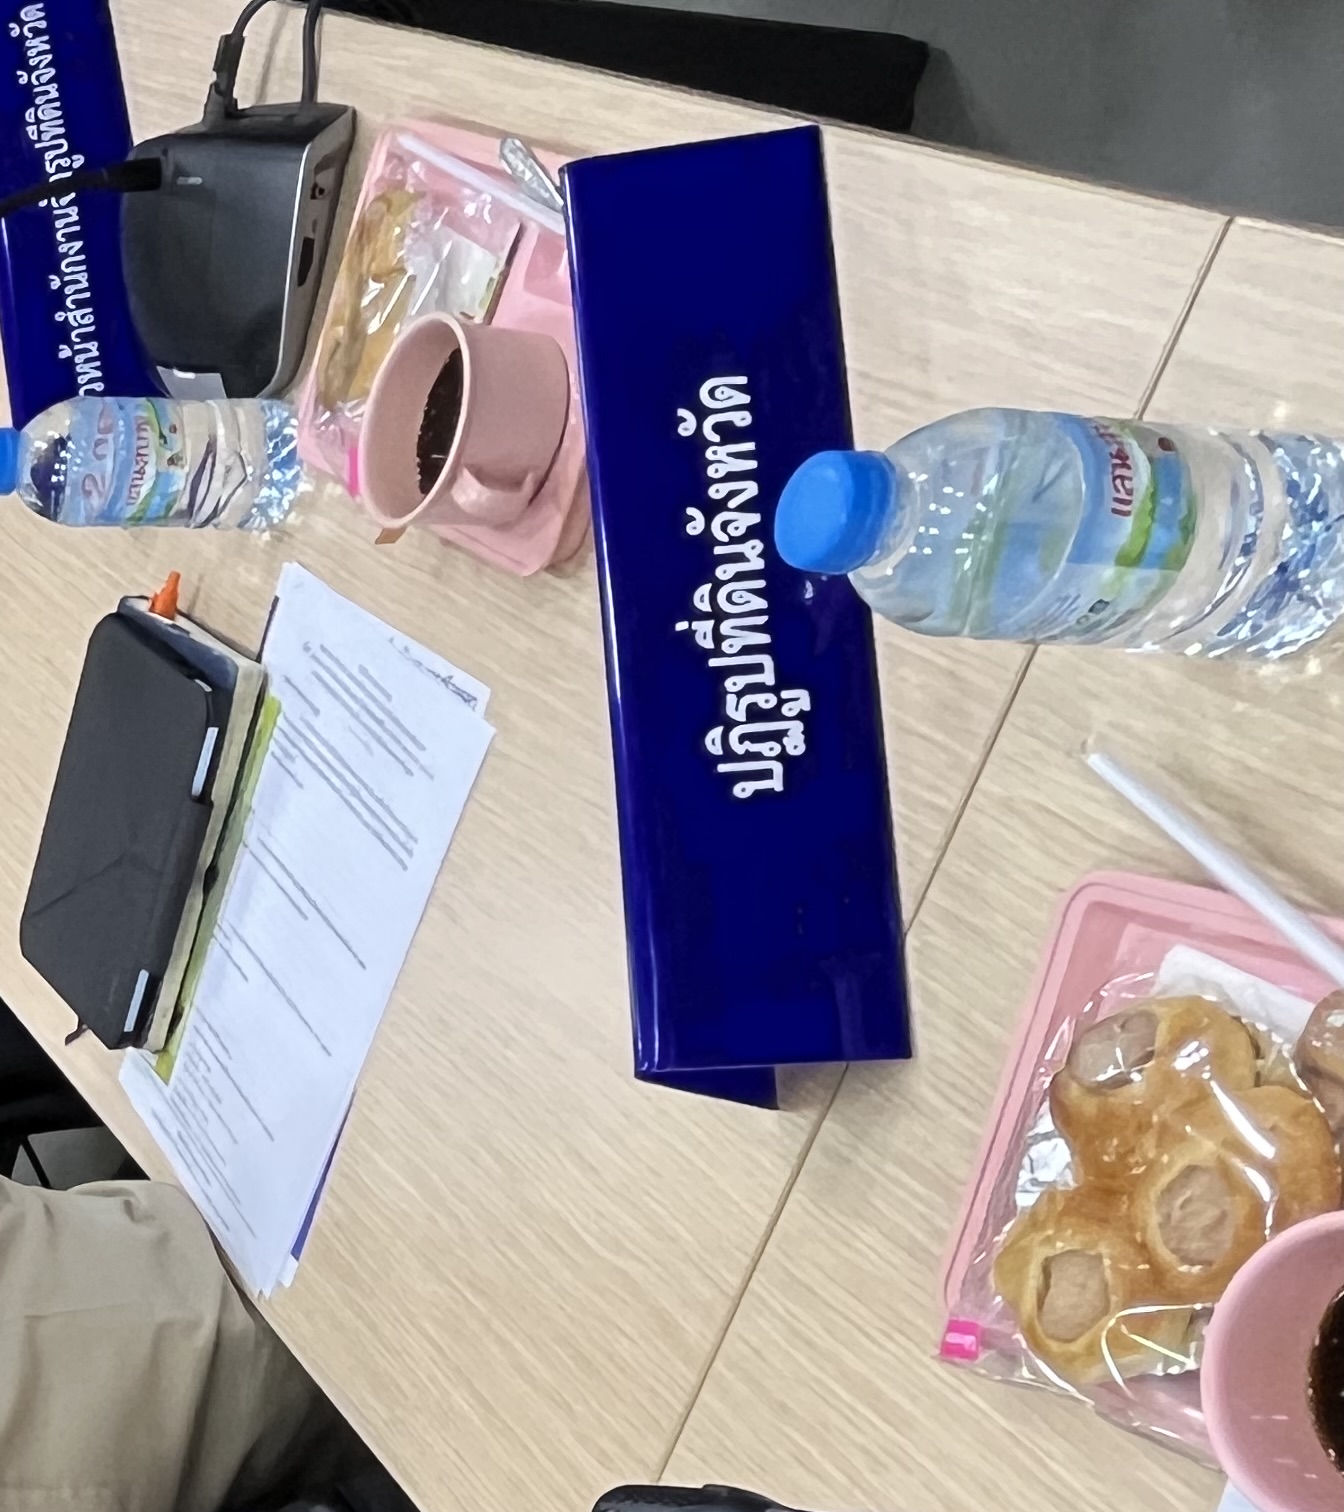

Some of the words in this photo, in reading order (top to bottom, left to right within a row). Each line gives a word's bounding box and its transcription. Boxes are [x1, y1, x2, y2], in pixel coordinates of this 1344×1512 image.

[675, 373, 811, 798] ปฏิรูปที่ดินจังหวัด
